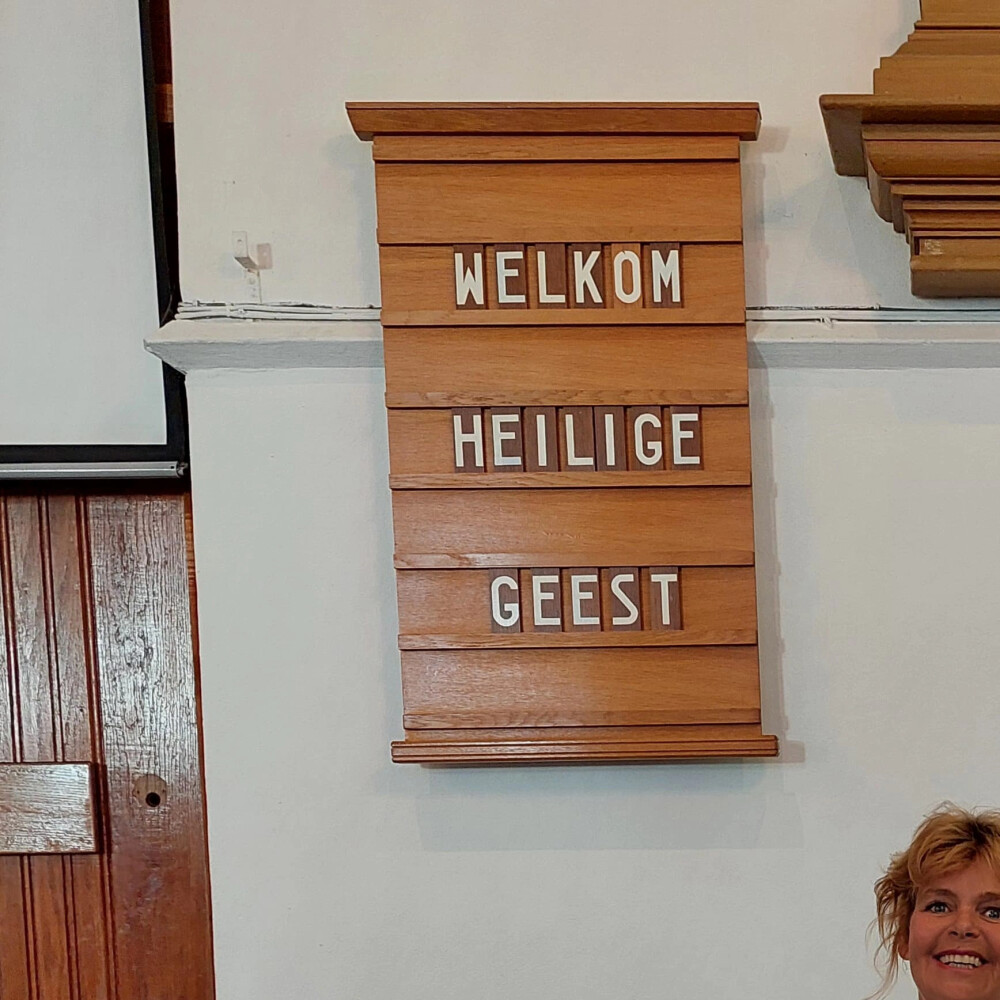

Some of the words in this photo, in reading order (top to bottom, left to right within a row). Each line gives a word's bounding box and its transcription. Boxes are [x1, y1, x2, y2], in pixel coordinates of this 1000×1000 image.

[454, 249, 681, 306] WELKOM
[453, 413, 701, 469] HEILIGE
[491, 573, 679, 628] GEEST
